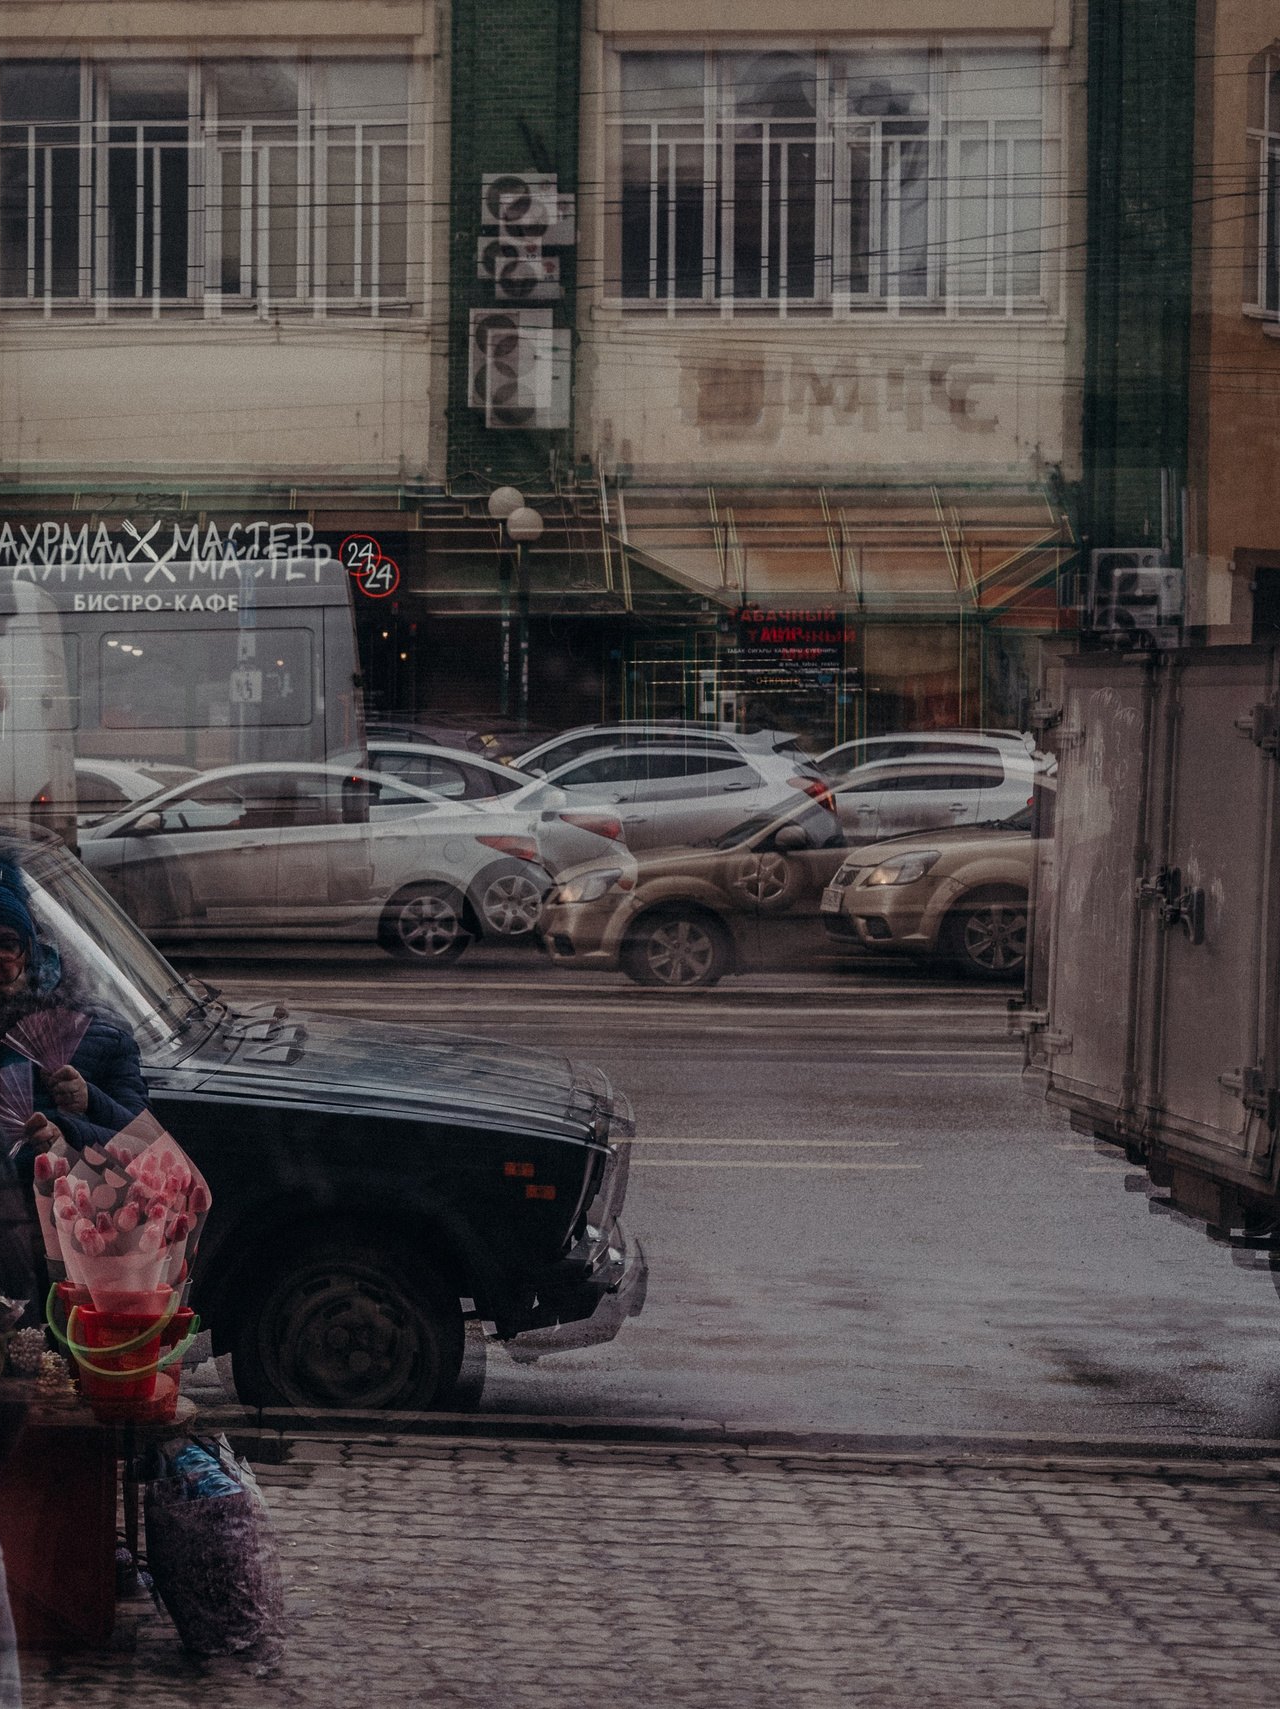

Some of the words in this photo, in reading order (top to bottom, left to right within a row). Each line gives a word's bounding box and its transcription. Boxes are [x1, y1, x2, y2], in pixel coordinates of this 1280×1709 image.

[171, 520, 315, 561] МАСТЕР
[347, 541, 374, 571] 24
[364, 563, 393, 590] 24
[74, 593, 239, 612] БИСТРО-КАФЕ
[728, 605, 837, 622] ТАБАЧНЫЙ
